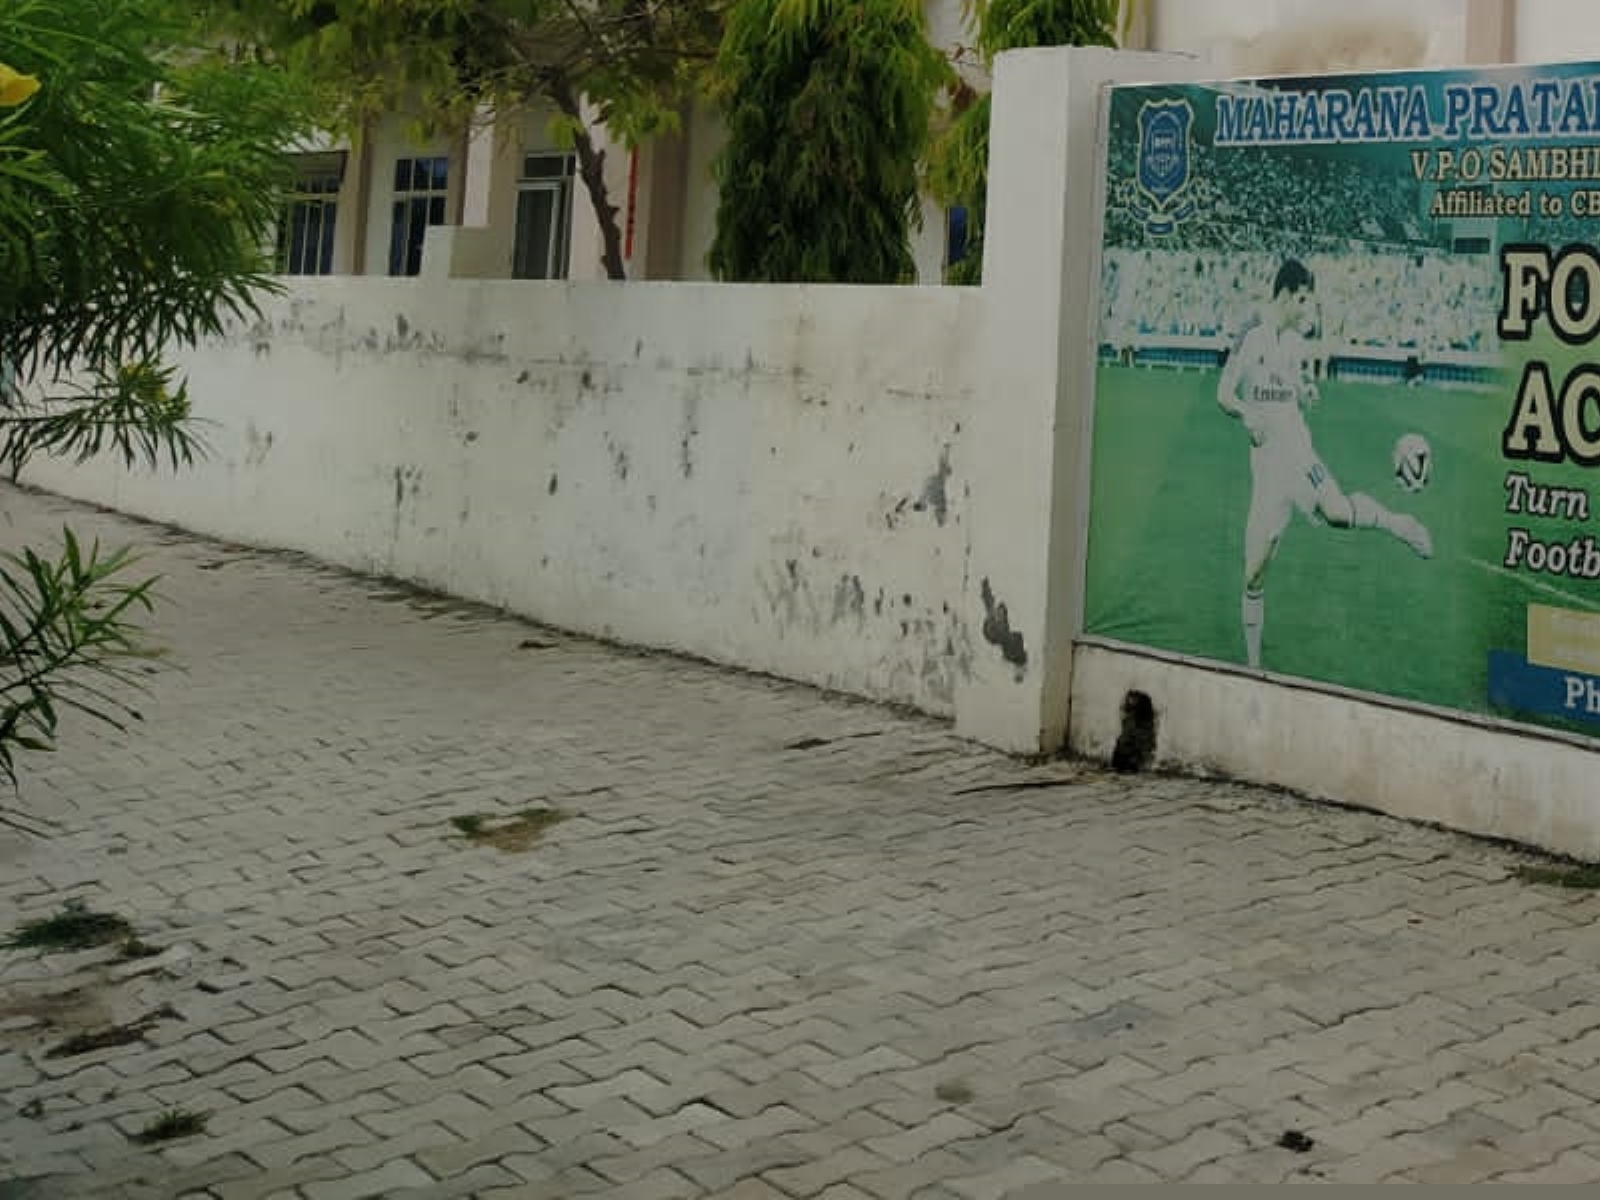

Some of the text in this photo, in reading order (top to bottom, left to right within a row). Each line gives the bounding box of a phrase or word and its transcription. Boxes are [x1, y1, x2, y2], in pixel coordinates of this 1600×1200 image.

[1216, 86, 1431, 144] MAHARANA
[1431, 191, 1530, 216] Affiliated
[1539, 193, 1563, 215] to
[1505, 474, 1588, 520] Turn
